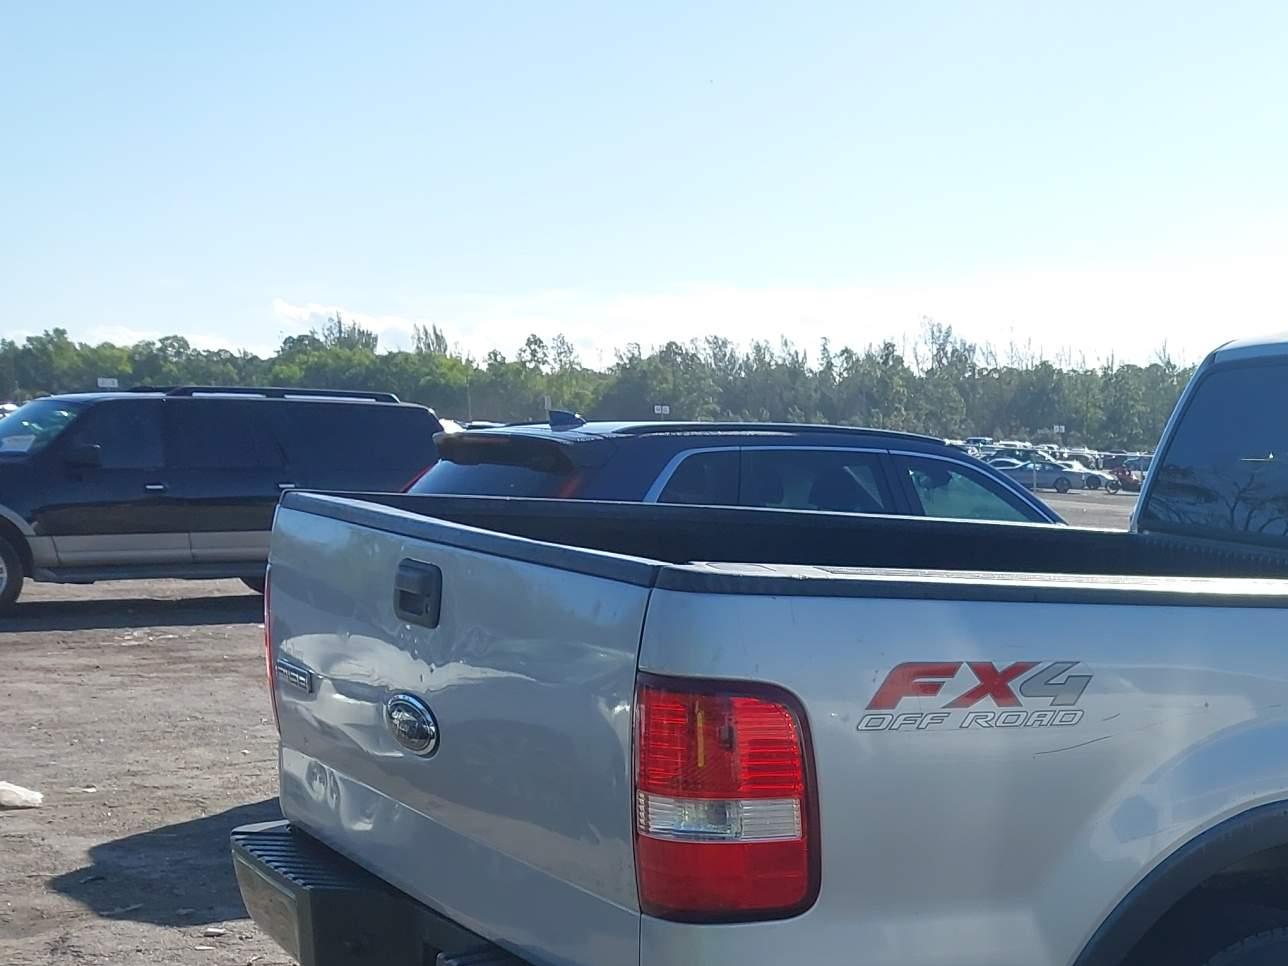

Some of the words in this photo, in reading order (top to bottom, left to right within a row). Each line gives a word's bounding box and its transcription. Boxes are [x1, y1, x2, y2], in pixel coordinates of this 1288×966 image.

[864, 660, 1093, 710] FX4
[856, 711, 951, 731] OFF
[960, 709, 1085, 729] ROAD
